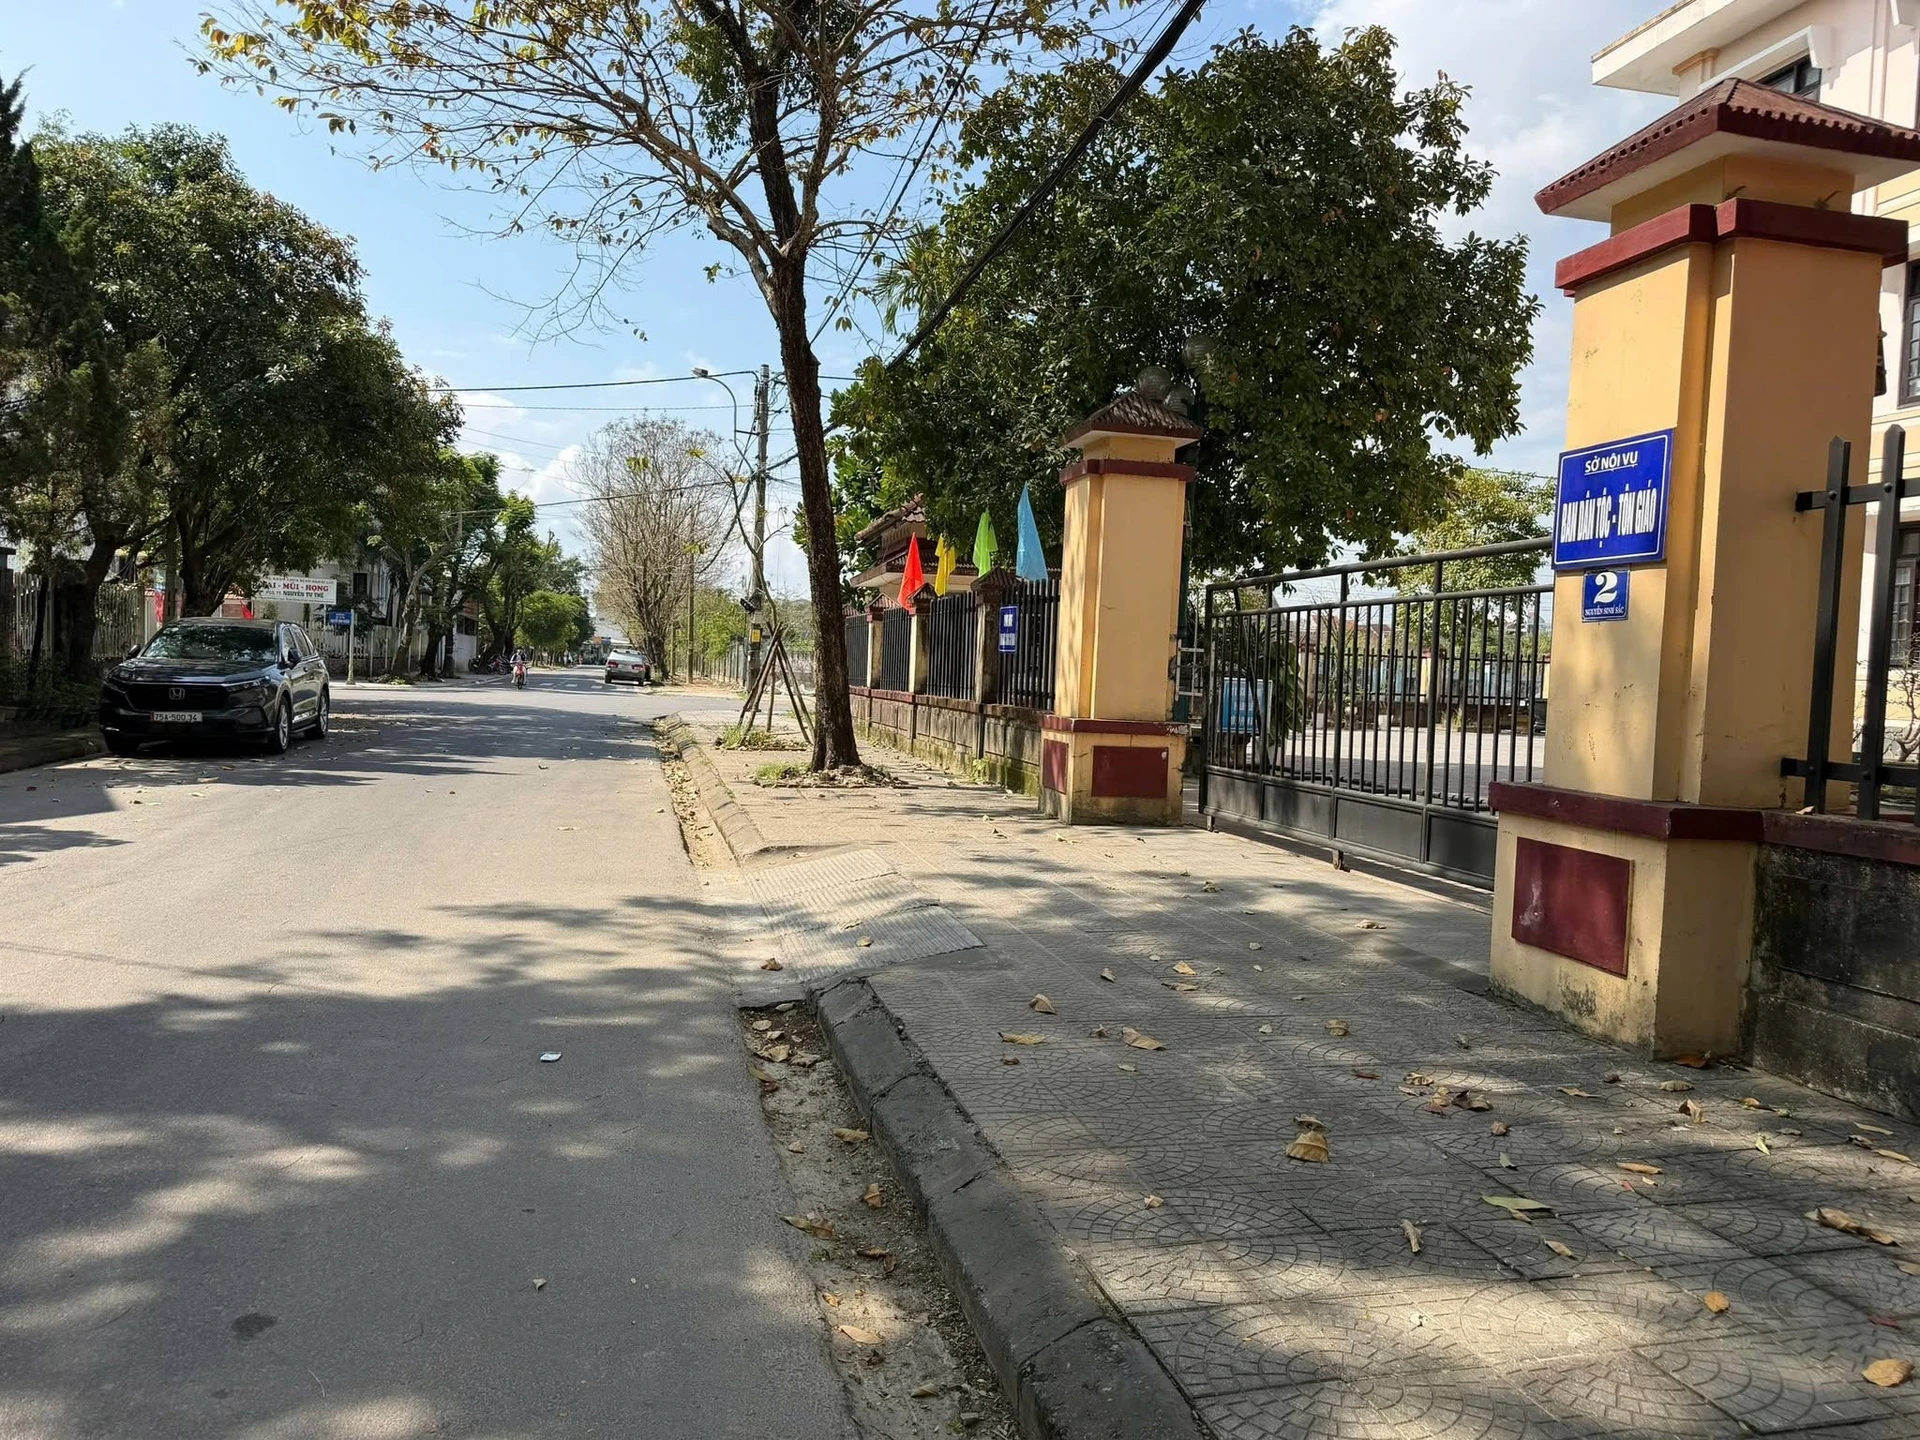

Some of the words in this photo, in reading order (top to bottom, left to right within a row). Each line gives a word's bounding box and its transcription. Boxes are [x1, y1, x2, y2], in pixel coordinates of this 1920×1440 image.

[1585, 455, 1600, 473] SỞ
[1601, 453, 1621, 471] NỘI
[1623, 450, 1639, 467] VỤ
[1560, 503, 1578, 543] BAN
[1577, 490, 1596, 541] DÂN
[1595, 487, 1612, 548] TỘC
[1617, 483, 1636, 536] TÔN
[1635, 480, 1657, 534] GIÁO
[305, 584, 329, 592] HỌNG
[1594, 571, 1618, 604] 2
